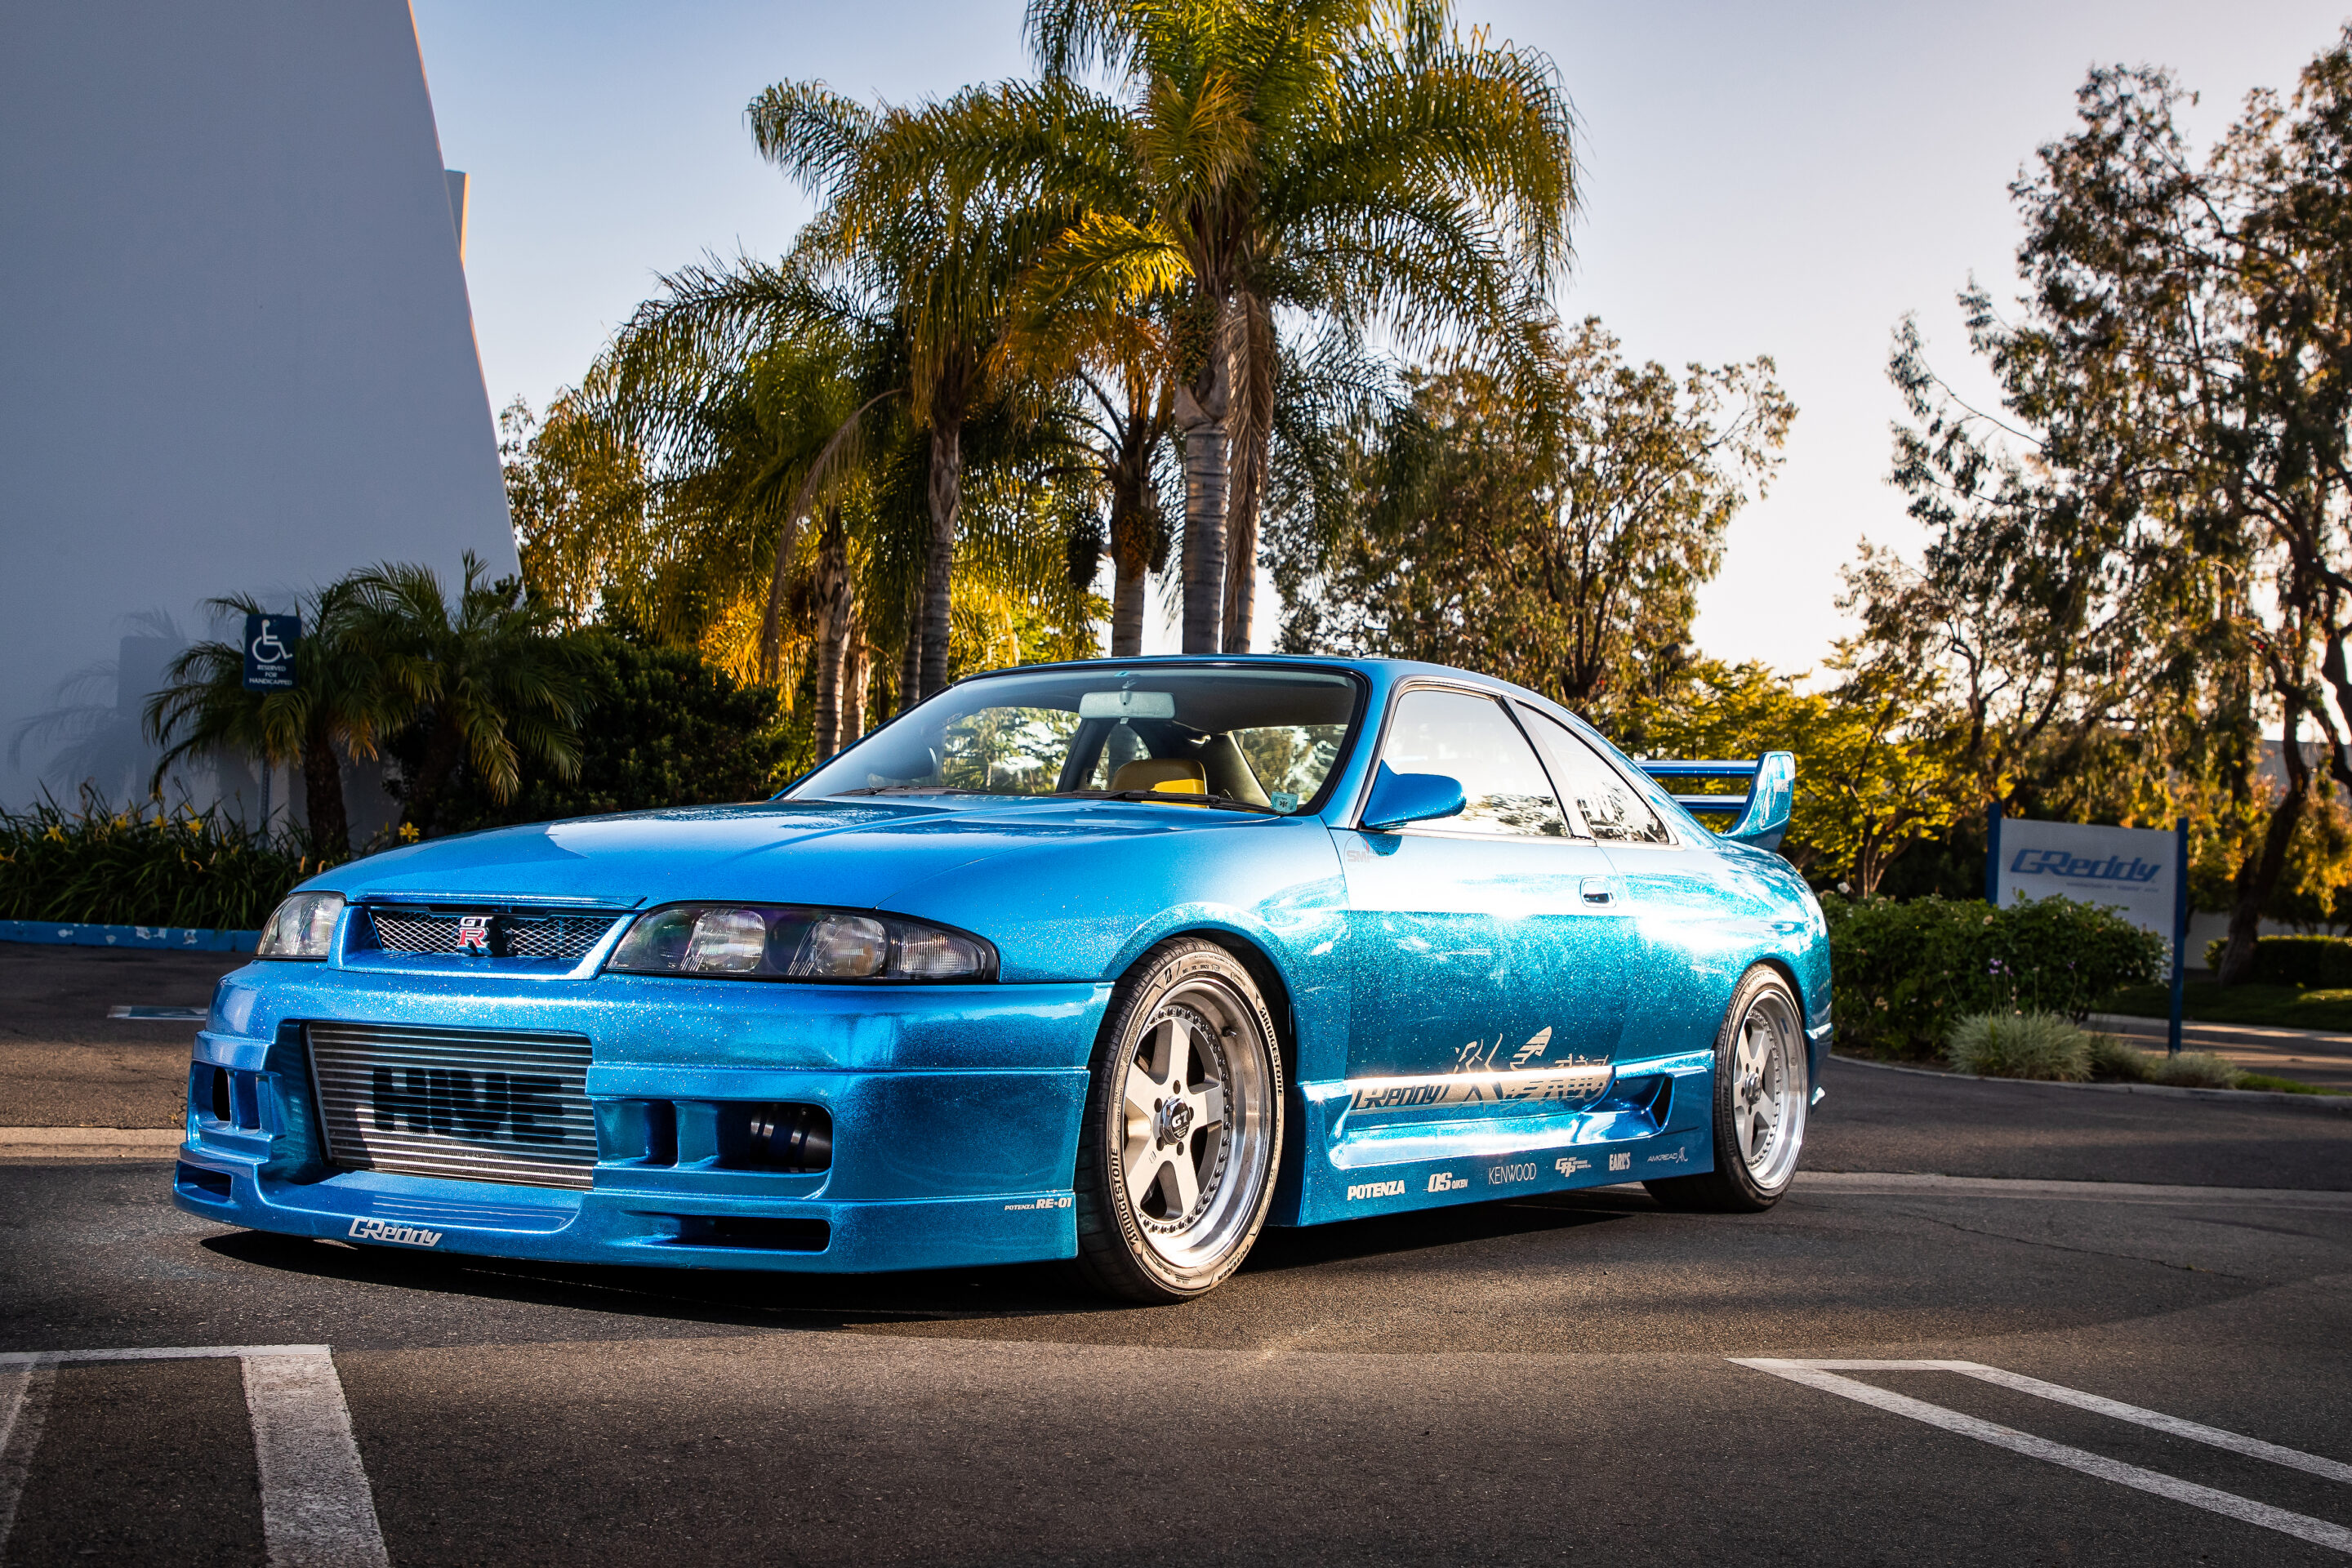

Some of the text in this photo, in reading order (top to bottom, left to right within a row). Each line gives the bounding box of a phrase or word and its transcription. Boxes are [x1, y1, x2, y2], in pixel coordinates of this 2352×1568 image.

[2010, 849, 2162, 882] GReddy
[460, 916, 494, 927] GT
[1488, 1162, 1537, 1185] KENWOOD
[1111, 1147, 1139, 1246] BRIDGESTONE
[1347, 1179, 1405, 1201] POTENZA
[1036, 1197, 1072, 1209] RE-01
[348, 1217, 443, 1247] GReddy
